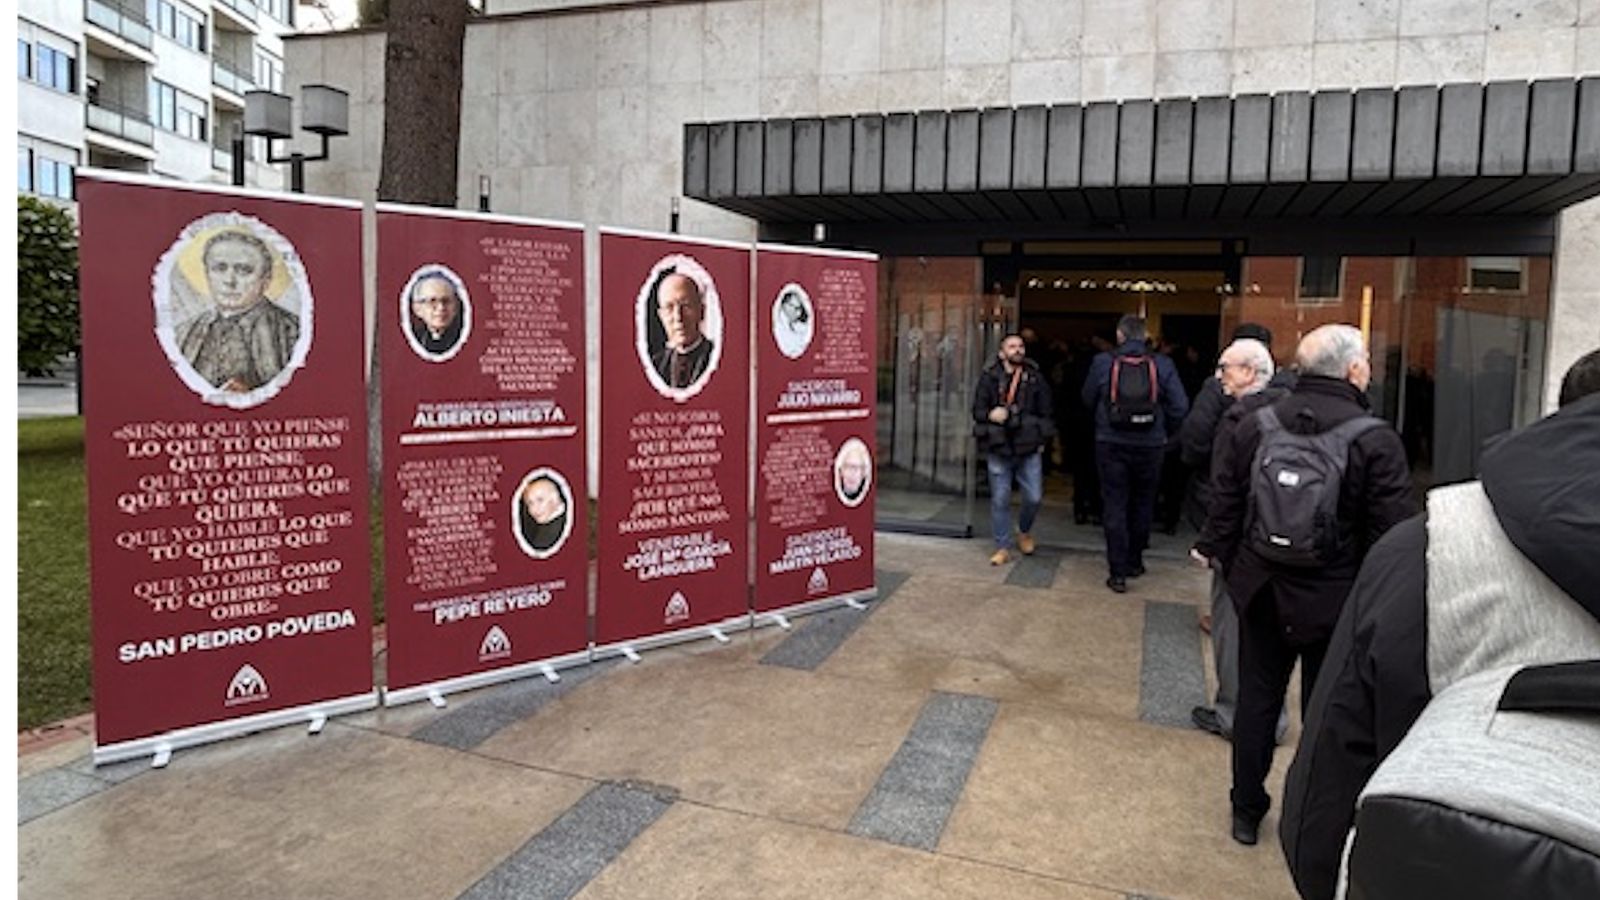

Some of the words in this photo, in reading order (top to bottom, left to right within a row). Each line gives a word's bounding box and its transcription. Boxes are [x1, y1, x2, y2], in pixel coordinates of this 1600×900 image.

[777, 392, 810, 408] JULIO
[202, 421, 247, 438] QUE
[250, 420, 281, 434] YO
[285, 418, 349, 433] PIENSE
[413, 407, 498, 427] ALBERTO
[499, 406, 565, 423] INIESTA
[127, 441, 161, 457] LO
[165, 438, 216, 456] QUE
[220, 436, 251, 453] TÚ
[254, 434, 341, 450] QUIERAS
[138, 475, 187, 491] QUE
[193, 472, 223, 487] YO
[226, 468, 303, 485] QUIERA
[306, 465, 334, 478] LO
[169, 456, 218, 473] QUE
[117, 492, 171, 514] QUE
[175, 488, 207, 506] TÚ
[212, 484, 305, 503] QUIERES
[307, 479, 350, 495] QUE
[116, 531, 166, 549] QUE
[171, 527, 203, 542] YO
[207, 521, 276, 538] HABLE
[278, 517, 306, 531] LO
[309, 511, 353, 529] QUE
[148, 544, 183, 561] TÚ
[186, 534, 281, 557] QUIERES
[284, 530, 329, 548] QUE
[133, 579, 183, 598] QUE
[187, 575, 219, 589] YO
[222, 567, 278, 586] OBRE
[280, 560, 342, 578] COMO
[151, 596, 183, 612] TÚ
[187, 582, 282, 608] QUIERES
[285, 577, 331, 596] QUE
[434, 602, 481, 624] PEPE
[483, 590, 552, 615] REYERO
[119, 639, 176, 662] SAN
[181, 625, 262, 652] PEDRO
